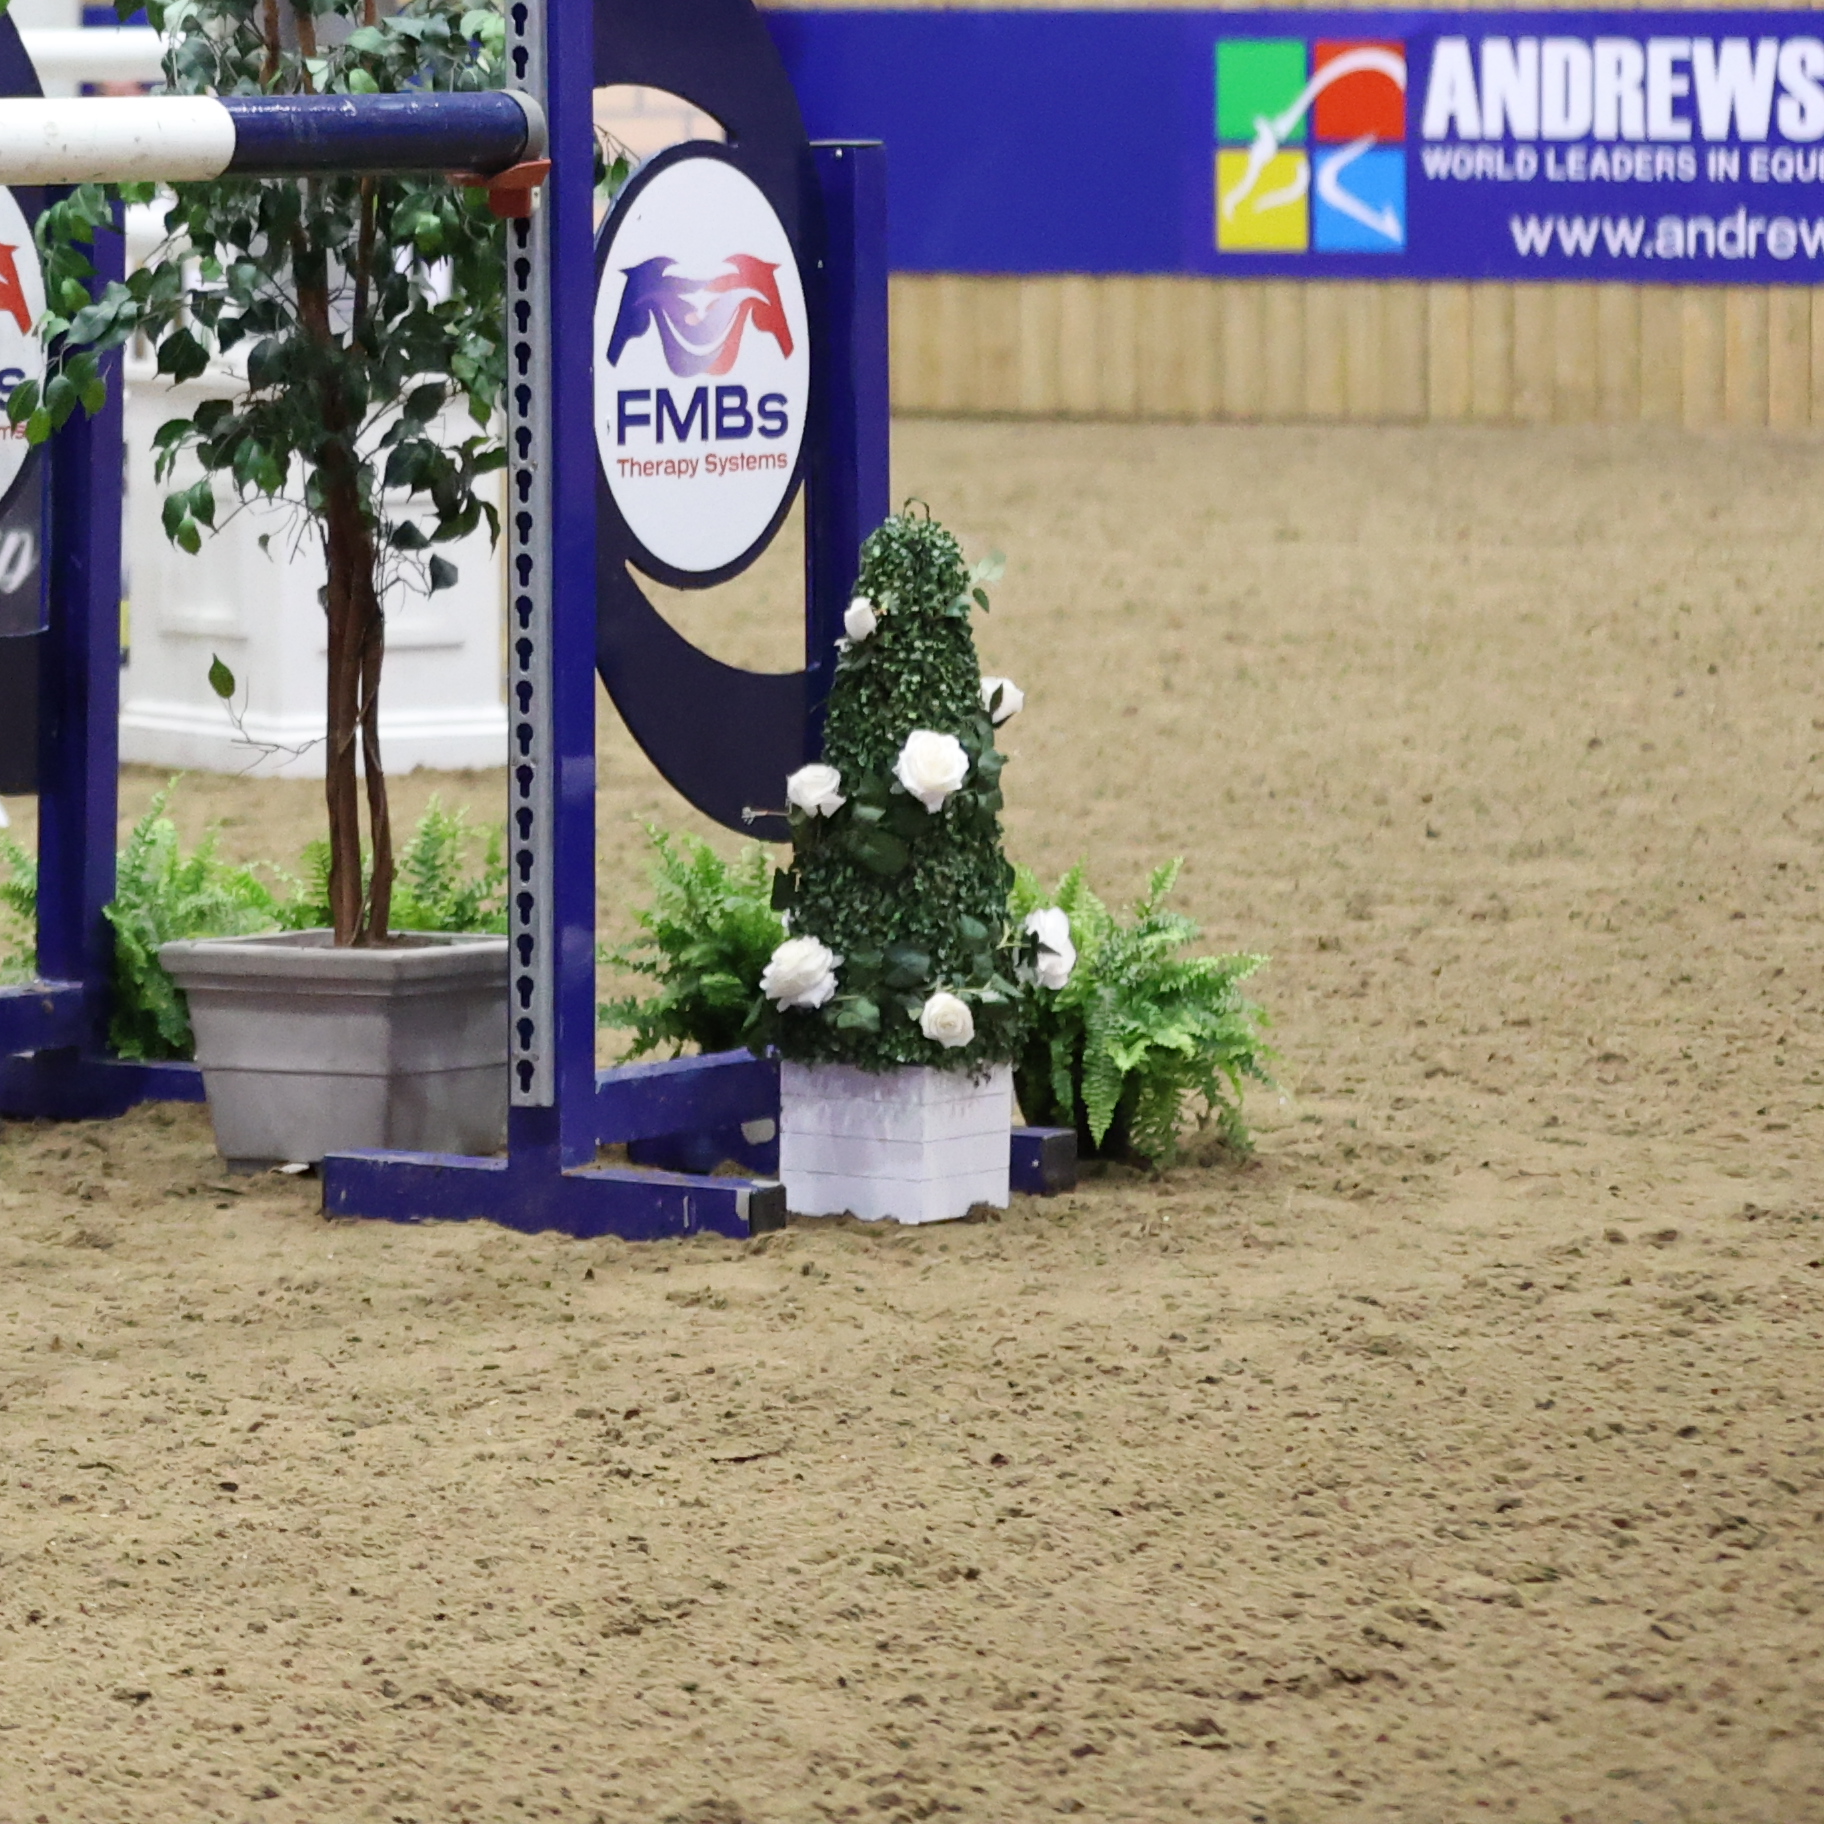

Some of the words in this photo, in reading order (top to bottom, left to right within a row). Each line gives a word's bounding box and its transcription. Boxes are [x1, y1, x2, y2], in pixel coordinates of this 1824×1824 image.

[1422, 36, 1824, 143] ANDREWS
[1421, 146, 1539, 182] WORLD
[1545, 147, 1697, 182] LEADERS
[1707, 149, 1740, 183] IN
[616, 384, 789, 446] FMBs
[617, 456, 700, 479] Therapy
[704, 451, 788, 477] Systems
